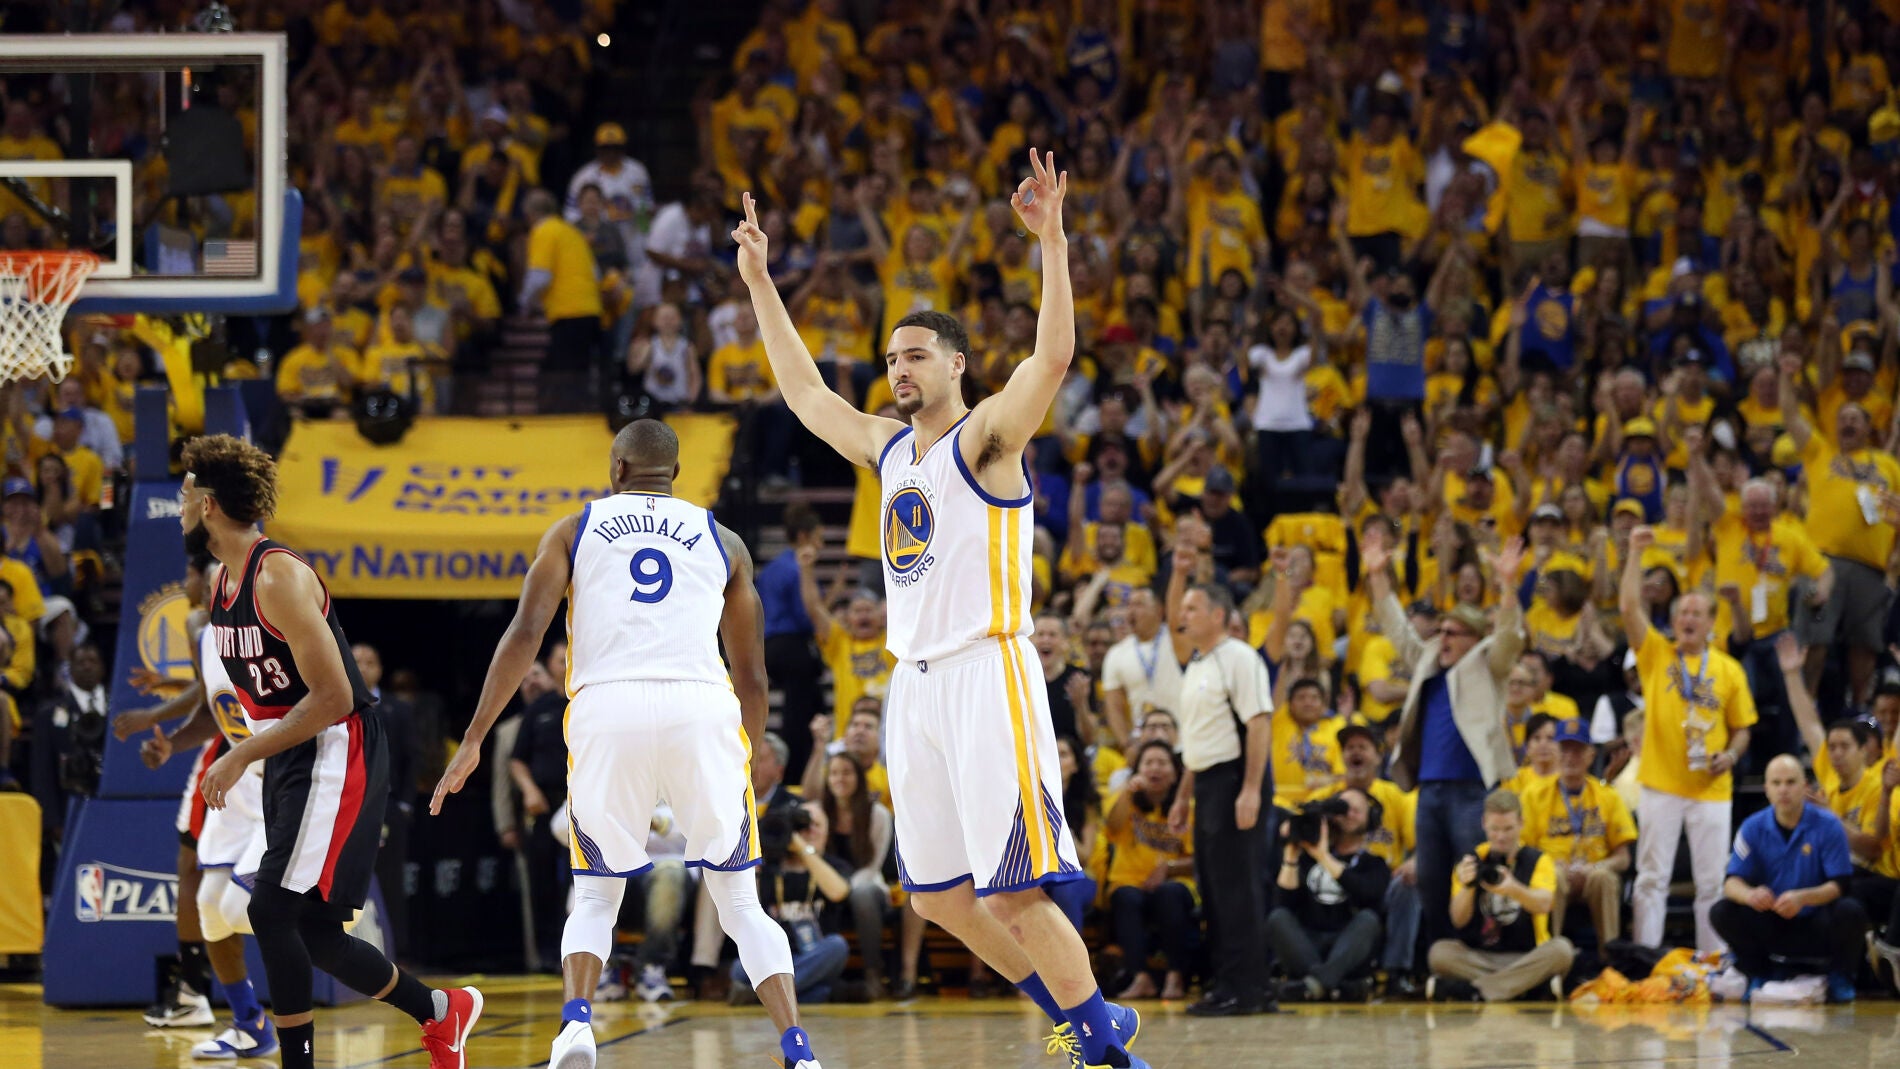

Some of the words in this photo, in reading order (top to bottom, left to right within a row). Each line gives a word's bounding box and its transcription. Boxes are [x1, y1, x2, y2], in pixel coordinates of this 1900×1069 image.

[409, 463, 523, 480] CITY
[403, 482, 611, 504] NATION
[593, 514, 702, 551] IGUODALA
[912, 505, 922, 528] 11
[302, 549, 342, 577] TY
[352, 545, 530, 579] NATIONA
[629, 548, 673, 603] 9
[248, 658, 290, 697] 23
